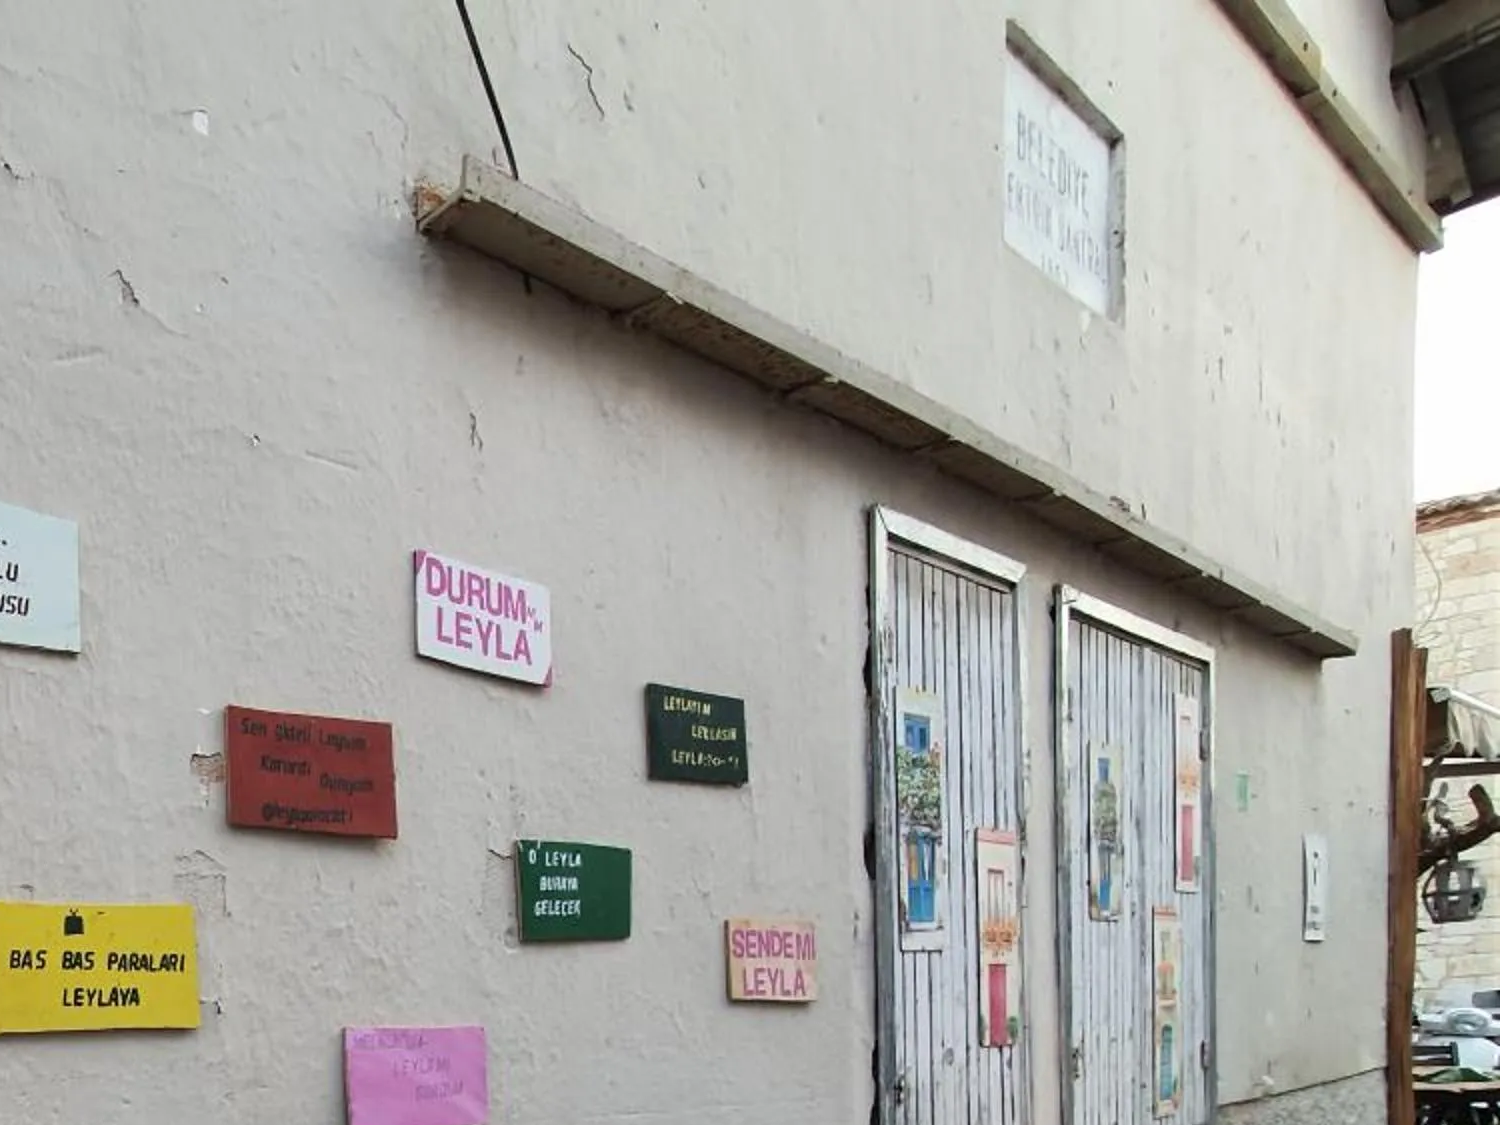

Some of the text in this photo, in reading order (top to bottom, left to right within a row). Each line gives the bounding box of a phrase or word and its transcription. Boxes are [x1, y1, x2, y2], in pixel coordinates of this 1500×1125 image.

[425, 556, 527, 625] DURUM
[436, 605, 533, 666] LEYLA
[545, 851, 582, 867] LEYLA
[9, 949, 47, 970] BAS
[61, 950, 95, 971] BAS
[743, 967, 806, 997] LEYLA
[62, 987, 141, 1008] LEYLAYA
